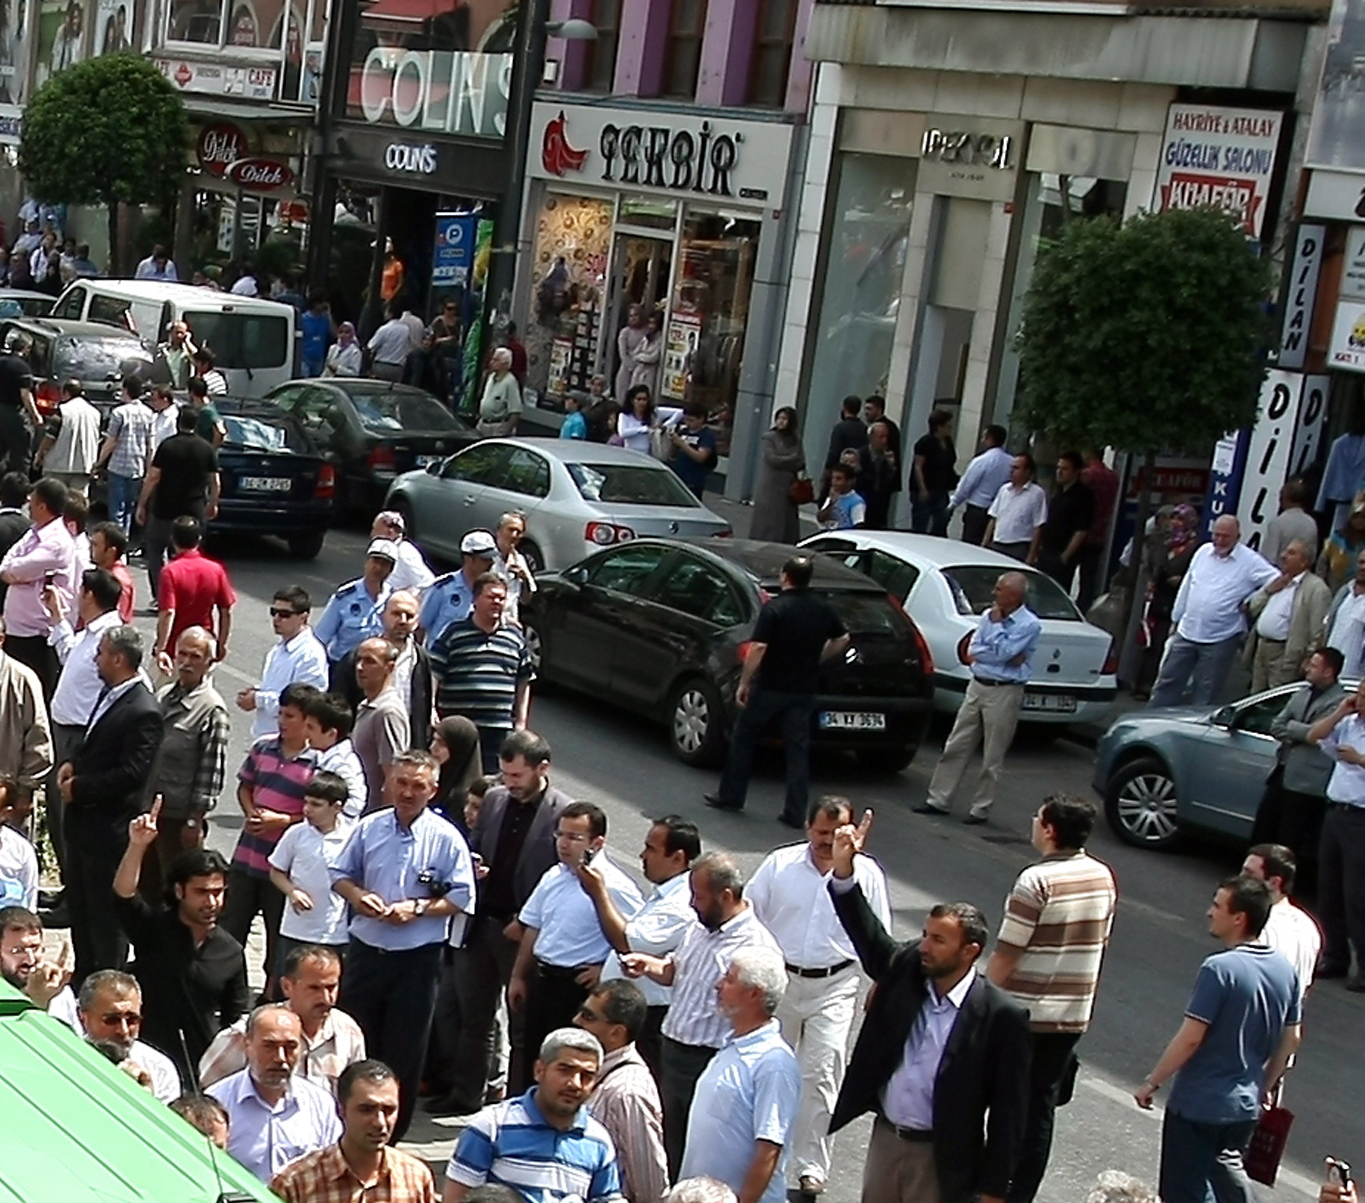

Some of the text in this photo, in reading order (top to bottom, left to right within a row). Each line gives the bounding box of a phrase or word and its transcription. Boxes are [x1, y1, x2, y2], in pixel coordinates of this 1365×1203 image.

[1232, 116, 1274, 137] ATALAY
[1222, 147, 1273, 175] SALONU
[1284, 238, 1317, 352] DİLAN
